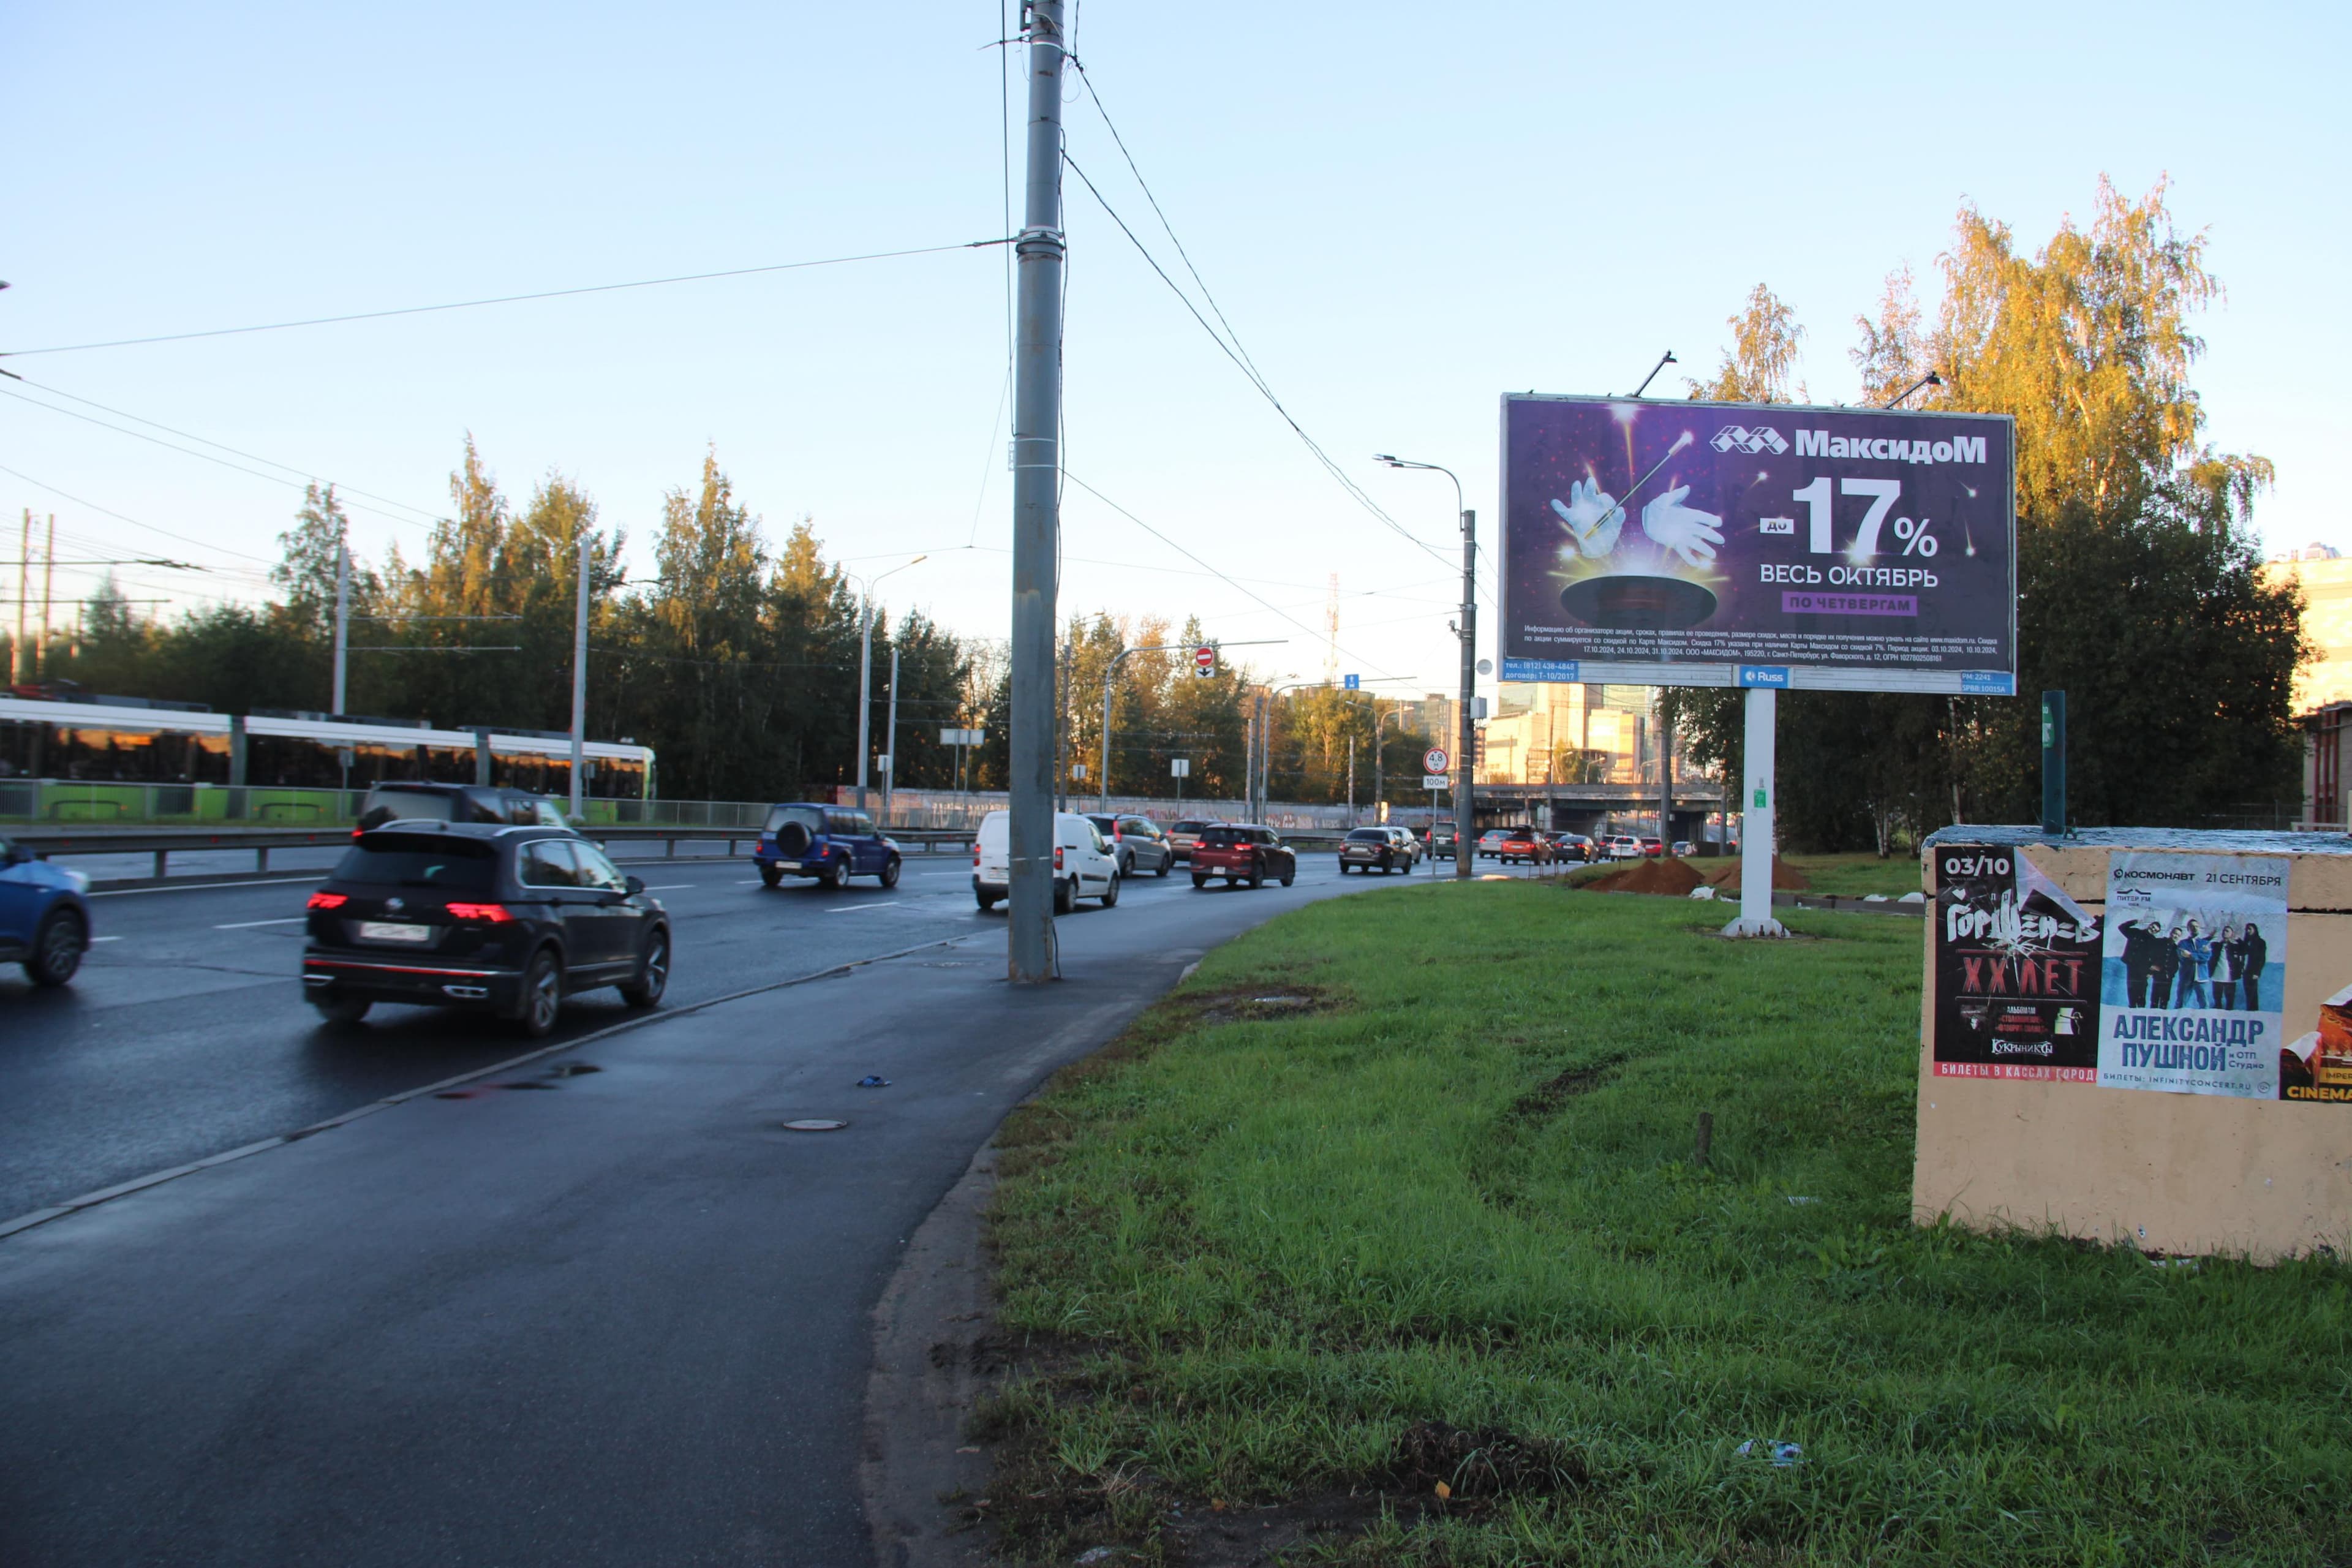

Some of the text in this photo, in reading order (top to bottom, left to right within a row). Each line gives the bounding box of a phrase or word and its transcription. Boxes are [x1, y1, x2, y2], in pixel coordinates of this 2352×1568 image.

[1760, 564, 1939, 587] ВЕСЬ ОКТЯБРЬ
[1790, 597, 1910, 611] ПО ЧЕТВЕРГАМ
[1524, 625, 1564, 633] Информацию
[1583, 646, 1616, 654] 17.10.2024,
[1757, 671, 1784, 682] Russ
[1945, 855, 2010, 876] 03/10
[2206, 873, 2281, 886] 21 СЕНТЯБРЯ
[2019, 958, 2083, 995] ЛЕТ
[2007, 1006, 2036, 1014] АЛЬБОМАМ
[2113, 1014, 2264, 1047] АЛЕКСАНДР
[2122, 1042, 2226, 1071] ПУШНОЙ
[1942, 1063, 2097, 1082] БИЛЕТЫ В КАССАХ ГОРОД
[2103, 1073, 2252, 1090] БИЛЕТЫ: INFINITYCONCERT.RU
